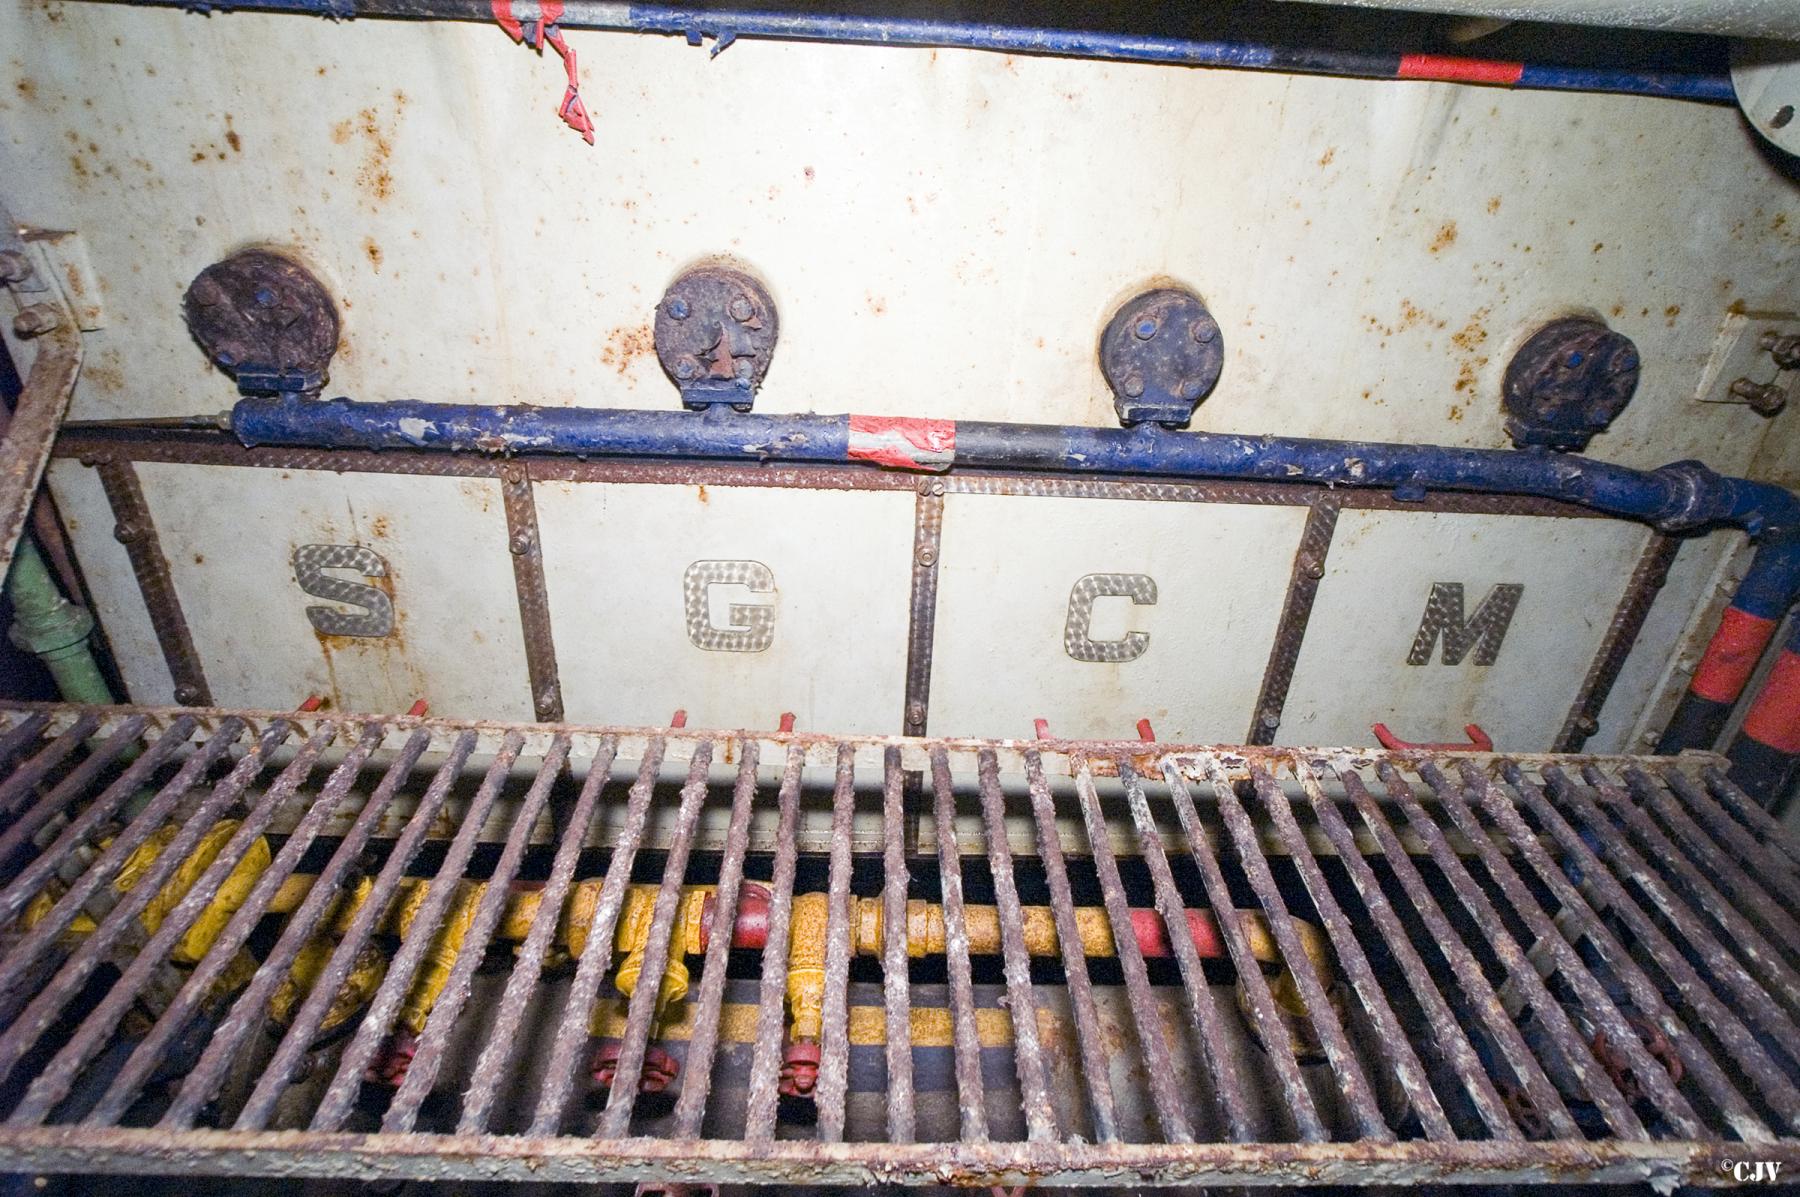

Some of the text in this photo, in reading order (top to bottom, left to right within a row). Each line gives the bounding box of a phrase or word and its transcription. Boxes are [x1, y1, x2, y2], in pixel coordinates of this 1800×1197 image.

[294, 544, 1524, 666] S G C M
